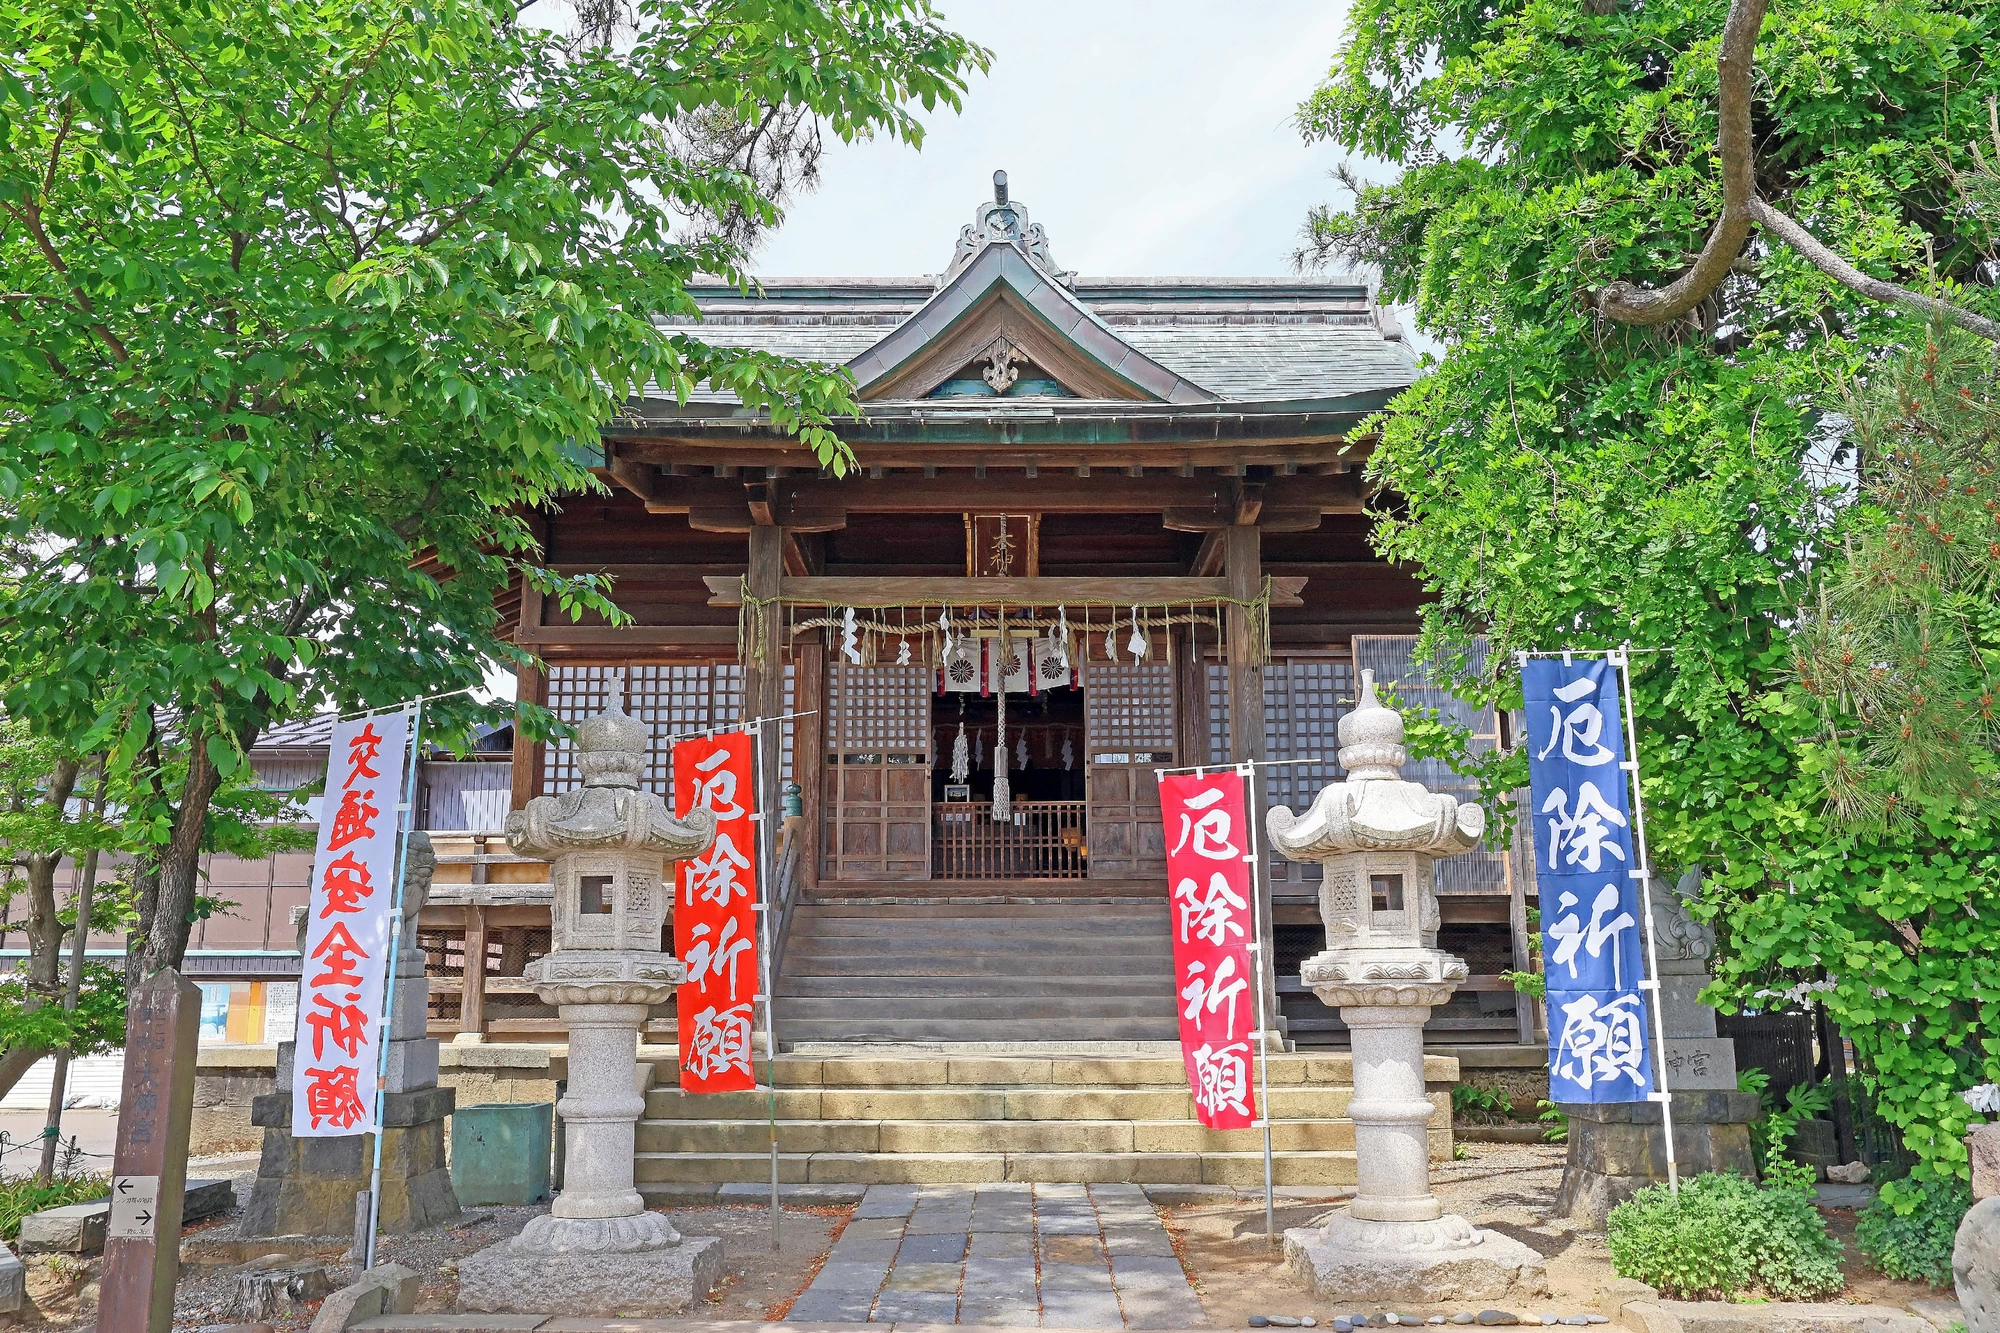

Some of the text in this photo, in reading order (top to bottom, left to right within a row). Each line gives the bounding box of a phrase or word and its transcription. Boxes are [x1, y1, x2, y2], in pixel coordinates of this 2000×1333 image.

[683, 749, 752, 1081] 厄除祈願
[1171, 788, 1249, 1117] 厄除祈願
[1538, 677, 1646, 1090] 厄除祈願
